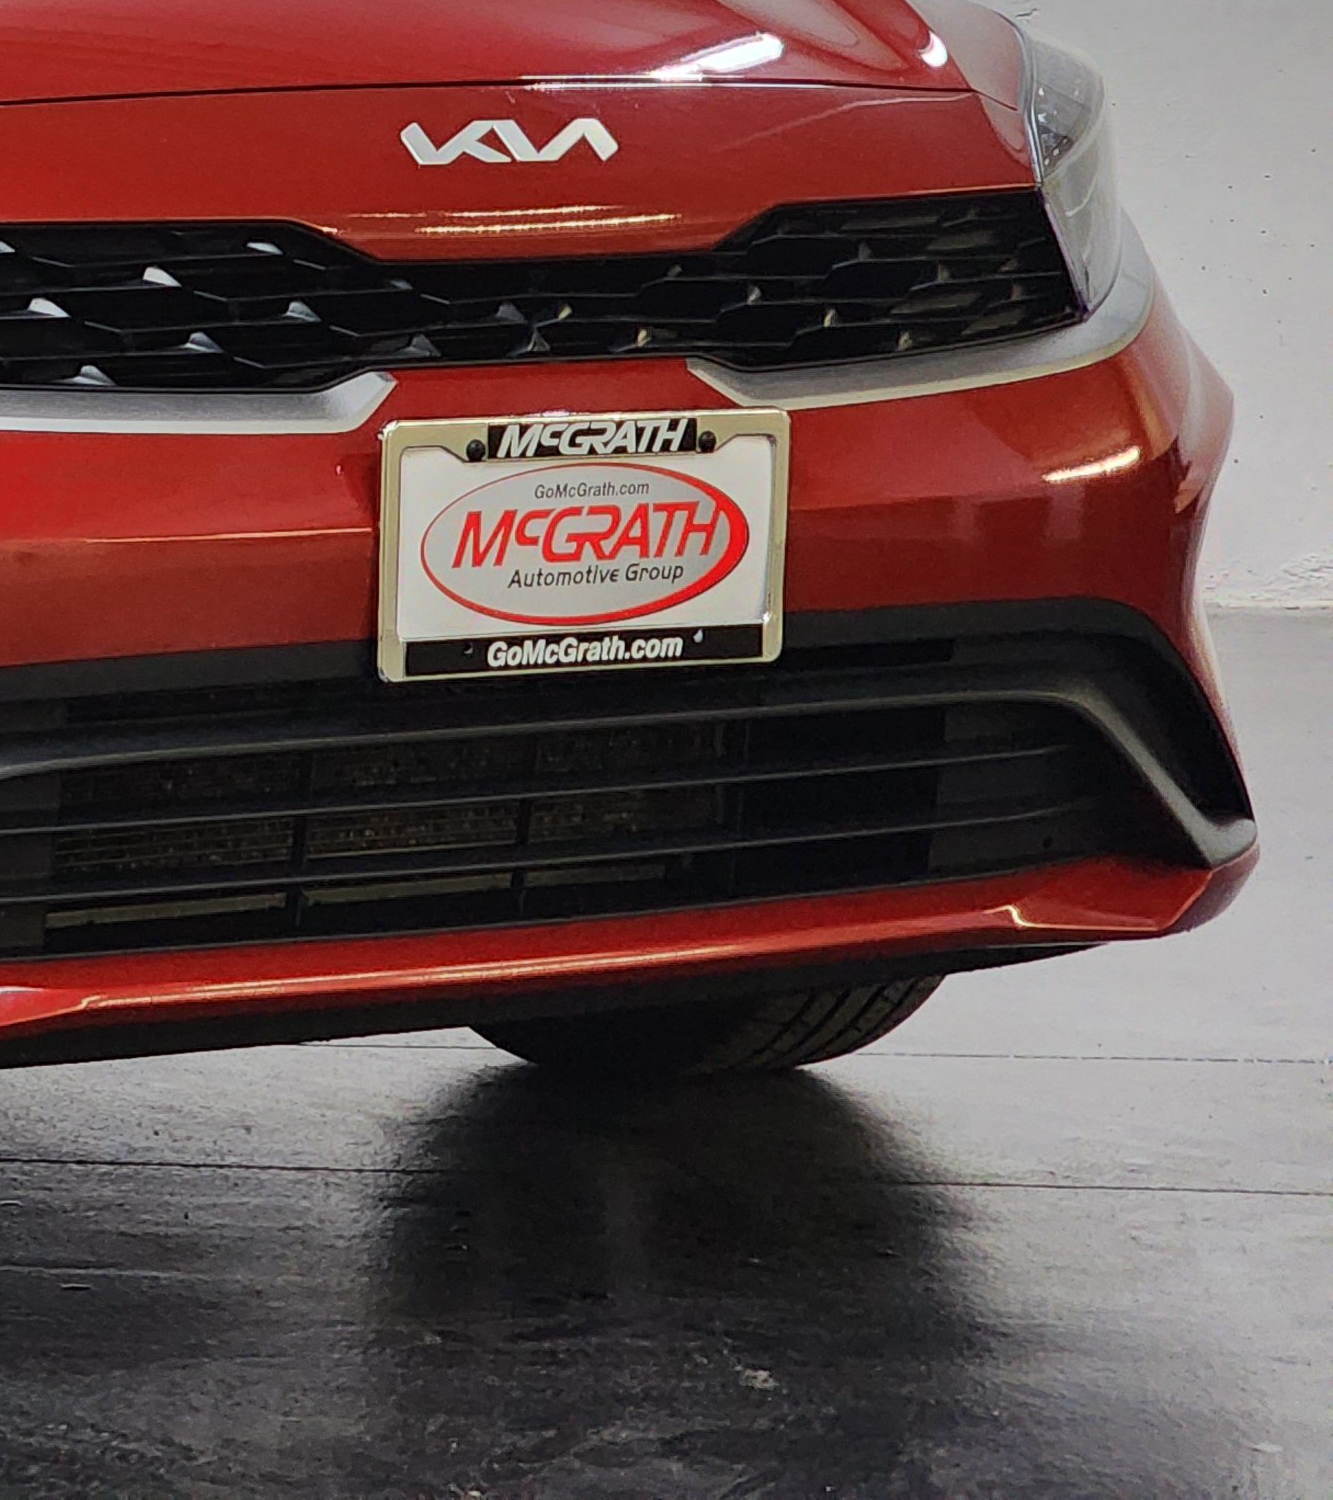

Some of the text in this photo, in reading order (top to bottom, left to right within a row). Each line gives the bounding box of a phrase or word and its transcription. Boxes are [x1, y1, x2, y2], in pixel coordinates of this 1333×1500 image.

[400, 118, 619, 166] KIA
[534, 481, 650, 499] GoMcGrath.com
[507, 563, 685, 589] Automotive Group
[487, 635, 683, 667] GoMcGrath.com
